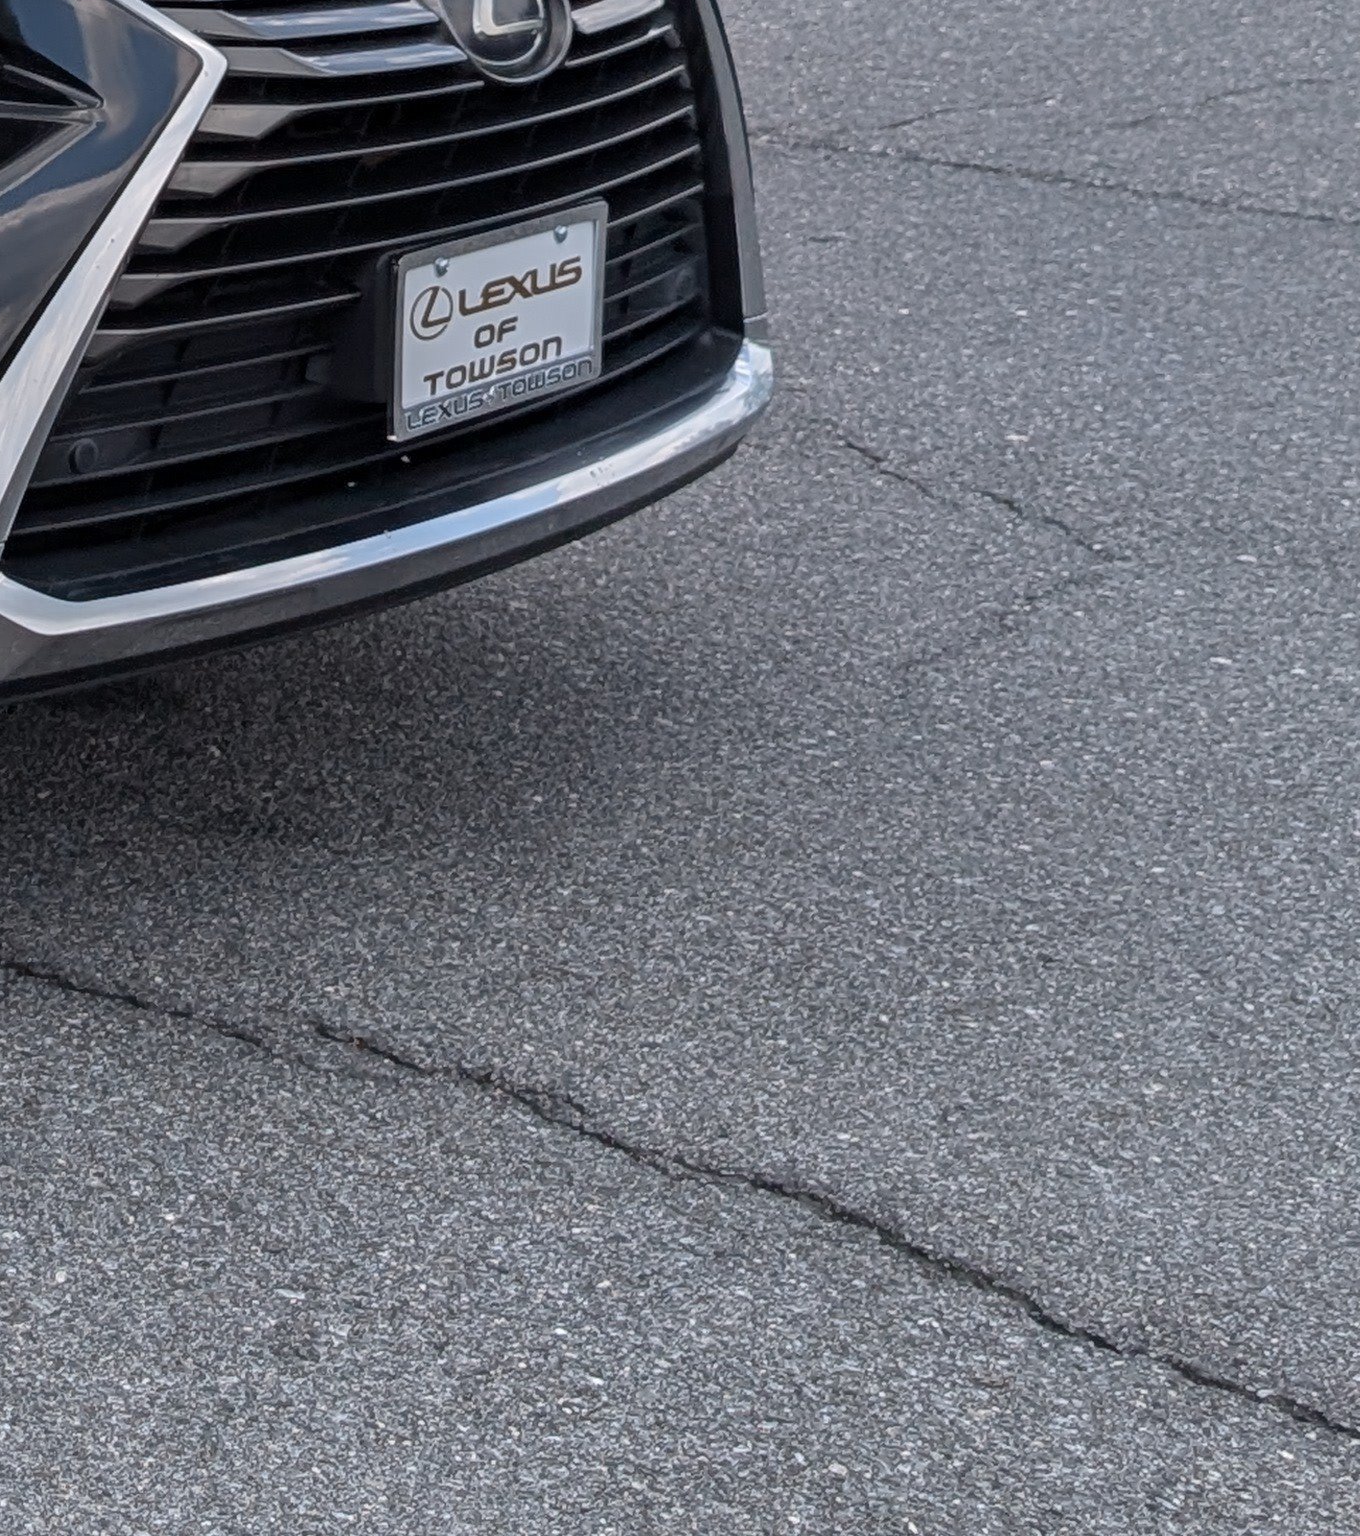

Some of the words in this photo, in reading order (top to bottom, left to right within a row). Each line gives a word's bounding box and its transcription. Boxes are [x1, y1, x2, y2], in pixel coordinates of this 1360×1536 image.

[458, 256, 583, 316] LEXUS
[474, 316, 519, 348] OF
[423, 335, 563, 395] TOWSON
[406, 388, 485, 430] LEXUS
